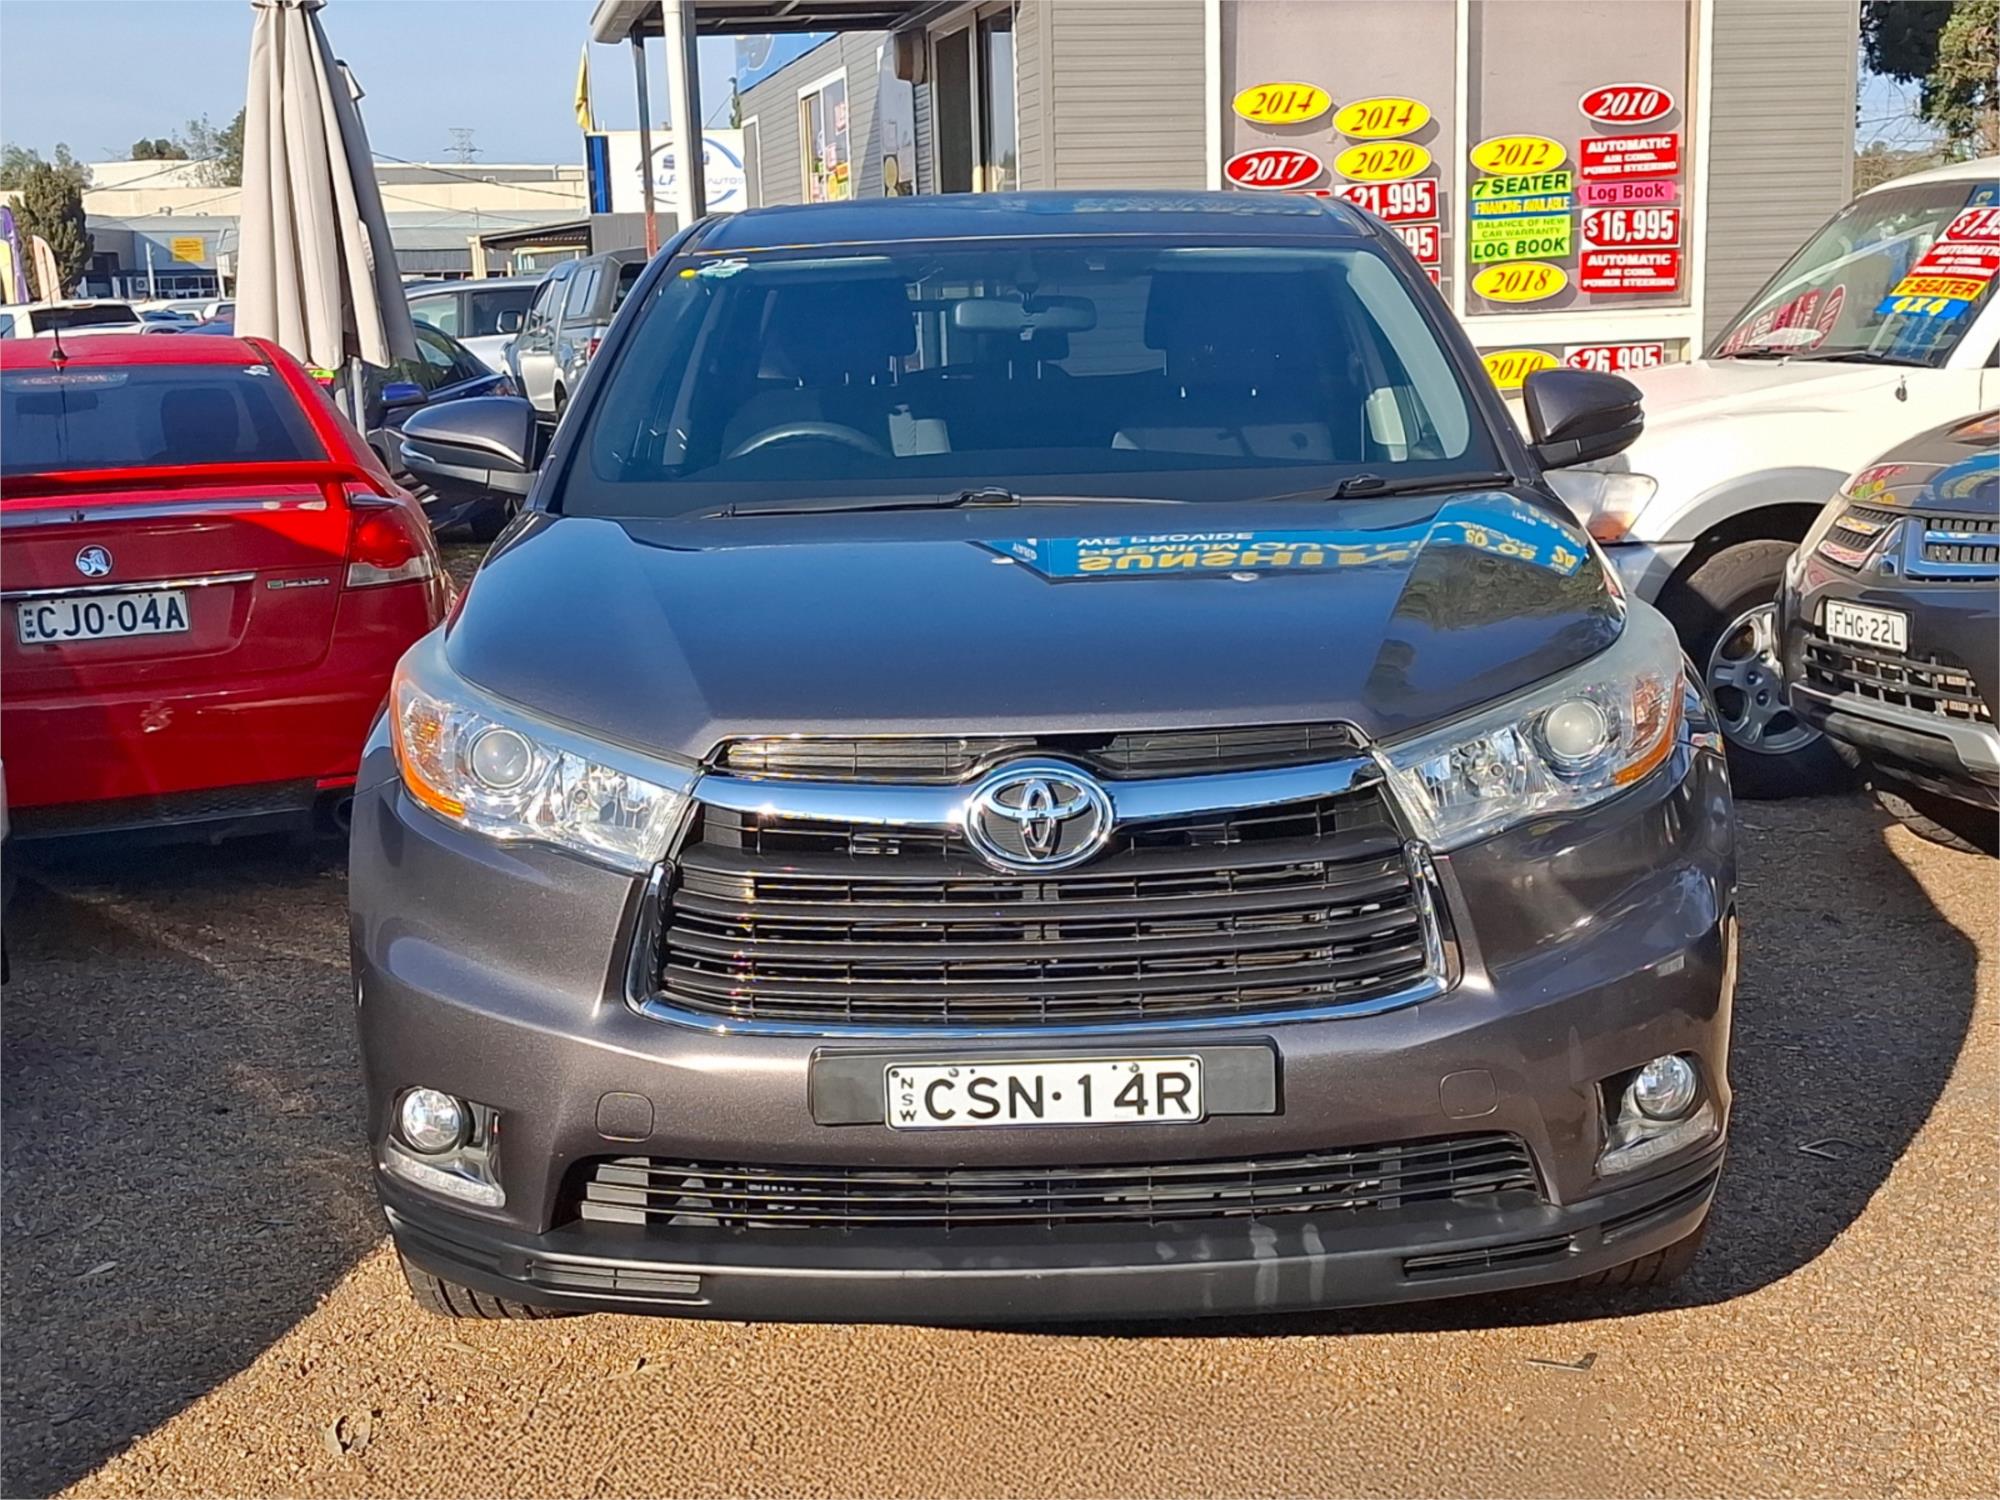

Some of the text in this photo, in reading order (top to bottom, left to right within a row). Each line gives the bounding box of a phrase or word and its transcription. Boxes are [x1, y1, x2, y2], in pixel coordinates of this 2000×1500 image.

[1250, 89, 1316, 115] 2014
[1594, 92, 1660, 116] 2010
[1350, 103, 1415, 131] 2014
[1488, 143, 1549, 167] 2012
[1586, 137, 1672, 153] AUTOMATIC
[1239, 155, 1309, 182] 2017
[1350, 148, 1415, 174] 2020
[1475, 174, 1568, 196] 7 SEATER
[1587, 184, 1665, 203] Log Book
[1343, 182, 1431, 218] 21,995
[1477, 218, 1566, 229] BALANCE OF NEW
[1482, 228, 1560, 238] CAR WARRANTY
[1585, 209, 1674, 242] $16,995
[1474, 236, 1568, 258] LOG BOOK
[1587, 254, 1672, 266] AUTOMATIC
[1488, 268, 1550, 294] 2018
[1910, 280, 1981, 296] SEATER
[900, 1077, 917, 1122] NSW
